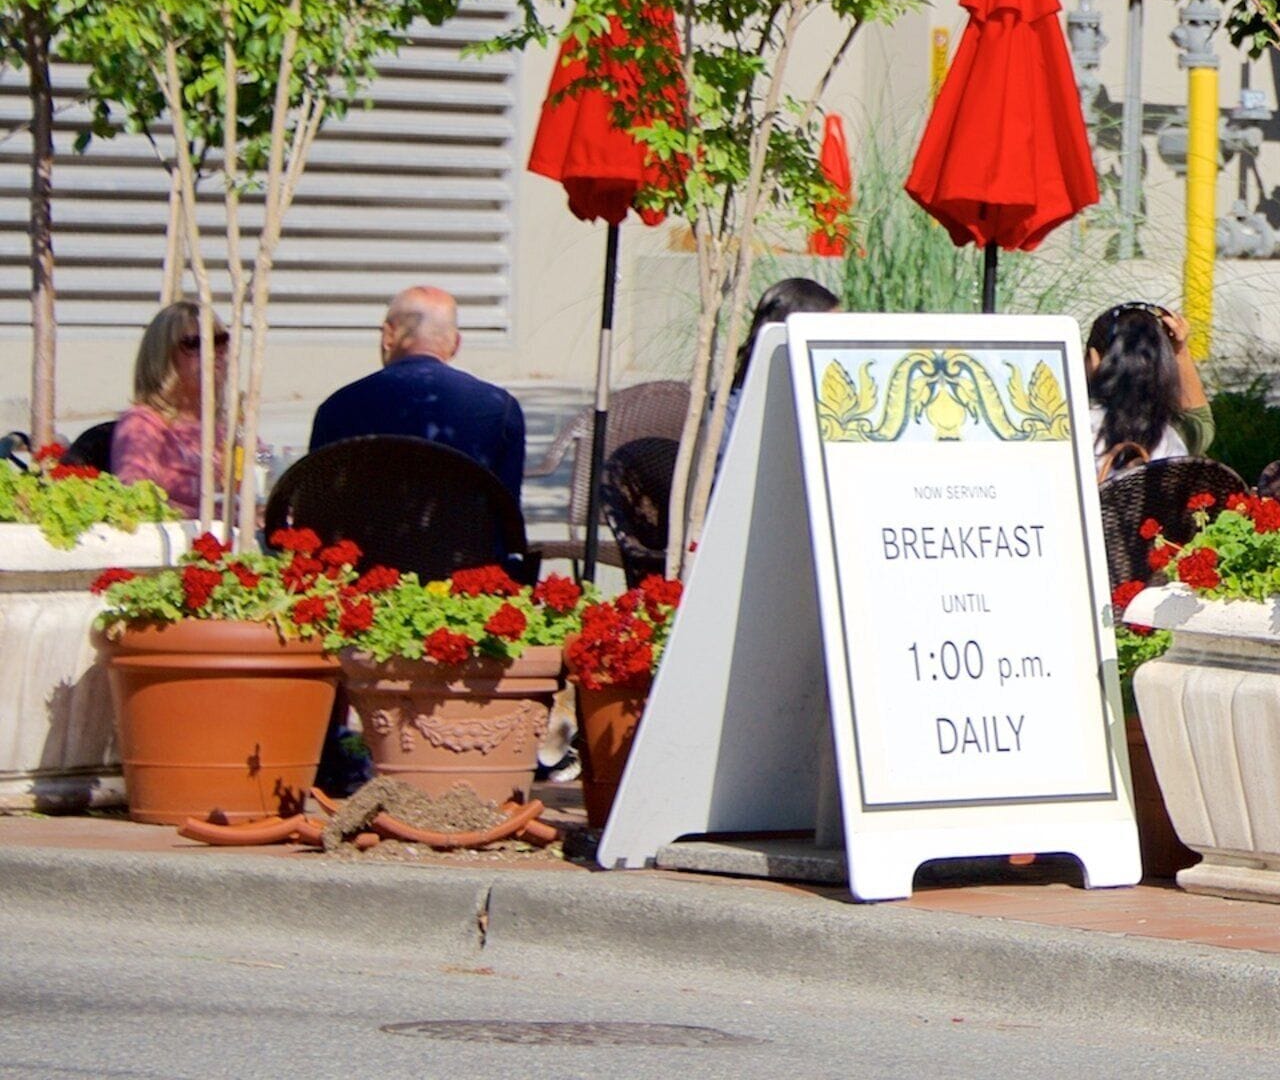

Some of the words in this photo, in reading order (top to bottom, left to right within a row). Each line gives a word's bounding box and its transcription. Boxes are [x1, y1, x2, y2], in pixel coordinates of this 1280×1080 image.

[913, 485, 943, 500] NOW
[946, 484, 997, 501] SERVING
[882, 525, 1045, 560] BREAKFAST
[941, 593, 991, 613] UNTIL
[908, 641, 983, 682] 1:00
[998, 657, 1051, 686] p.m.
[936, 715, 1025, 755] DAILY
